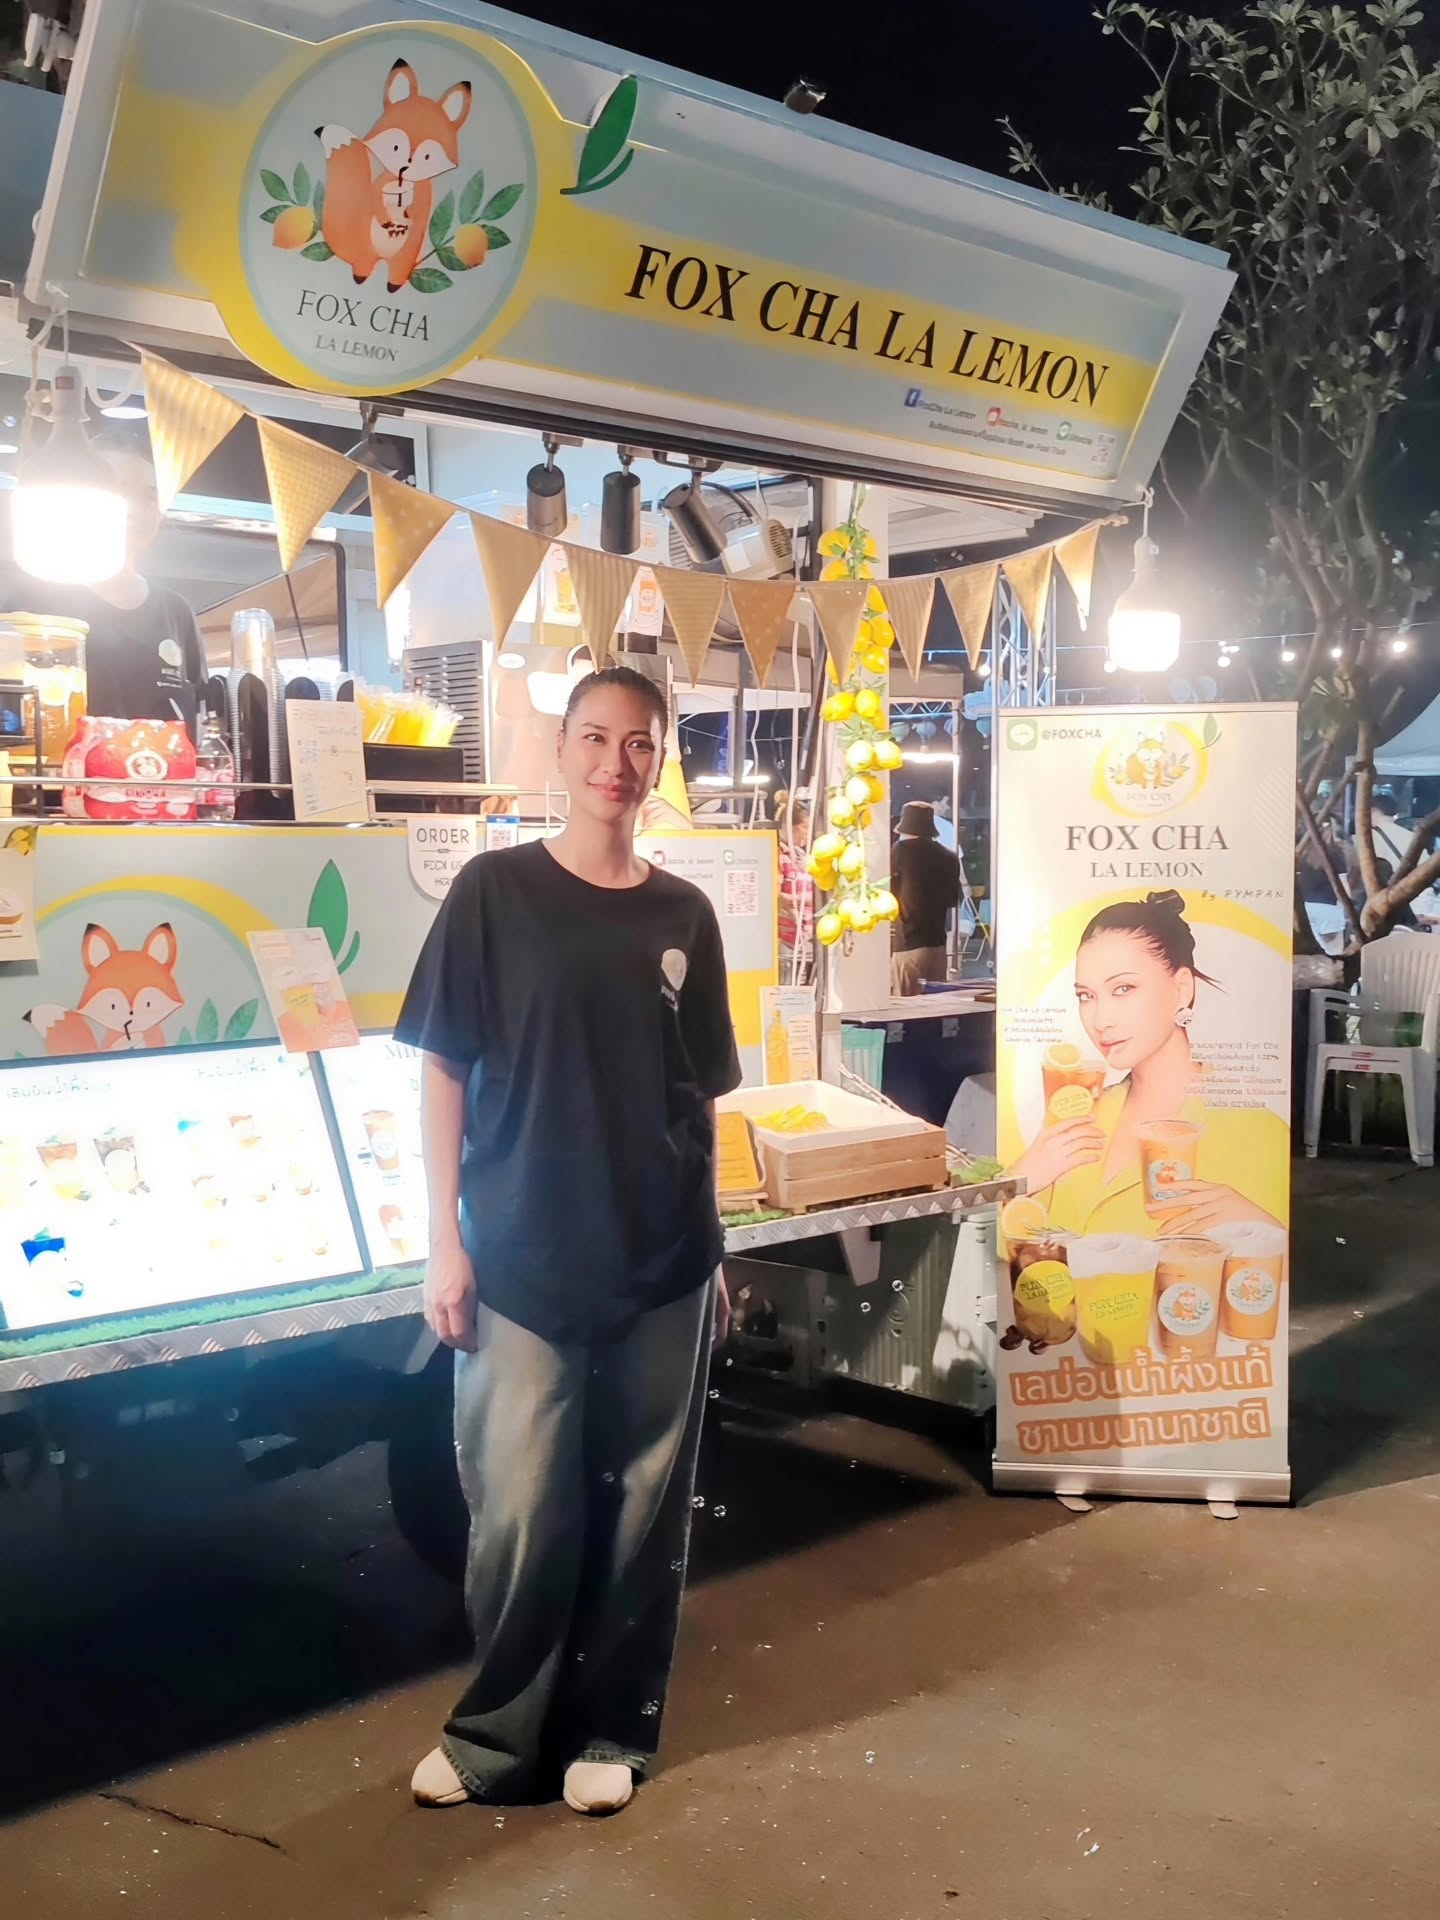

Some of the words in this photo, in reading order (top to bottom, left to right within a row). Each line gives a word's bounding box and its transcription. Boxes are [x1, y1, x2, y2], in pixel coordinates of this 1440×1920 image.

[297, 289, 361, 328] FOX
[369, 304, 430, 342] CHA
[624, 244, 750, 322] FOX
[759, 281, 861, 350] CHA
[874, 310, 936, 368] LA
[948, 329, 1110, 407] LEMON
[315, 334, 337, 352] LA
[341, 339, 399, 362] LEMON
[1041, 727, 1102, 740] @FOXCHA
[416, 828, 470, 844] ORDER
[1064, 825, 1139, 851] FOX
[1152, 825, 1231, 851] CHA
[1090, 862, 1118, 878] LA
[1125, 862, 1204, 878] LEMON
[1014, 1347, 1270, 1401] เลม่อนน้ำผึ้งแท้
[1021, 1401, 1268, 1449] ชานมนานาชาติ
